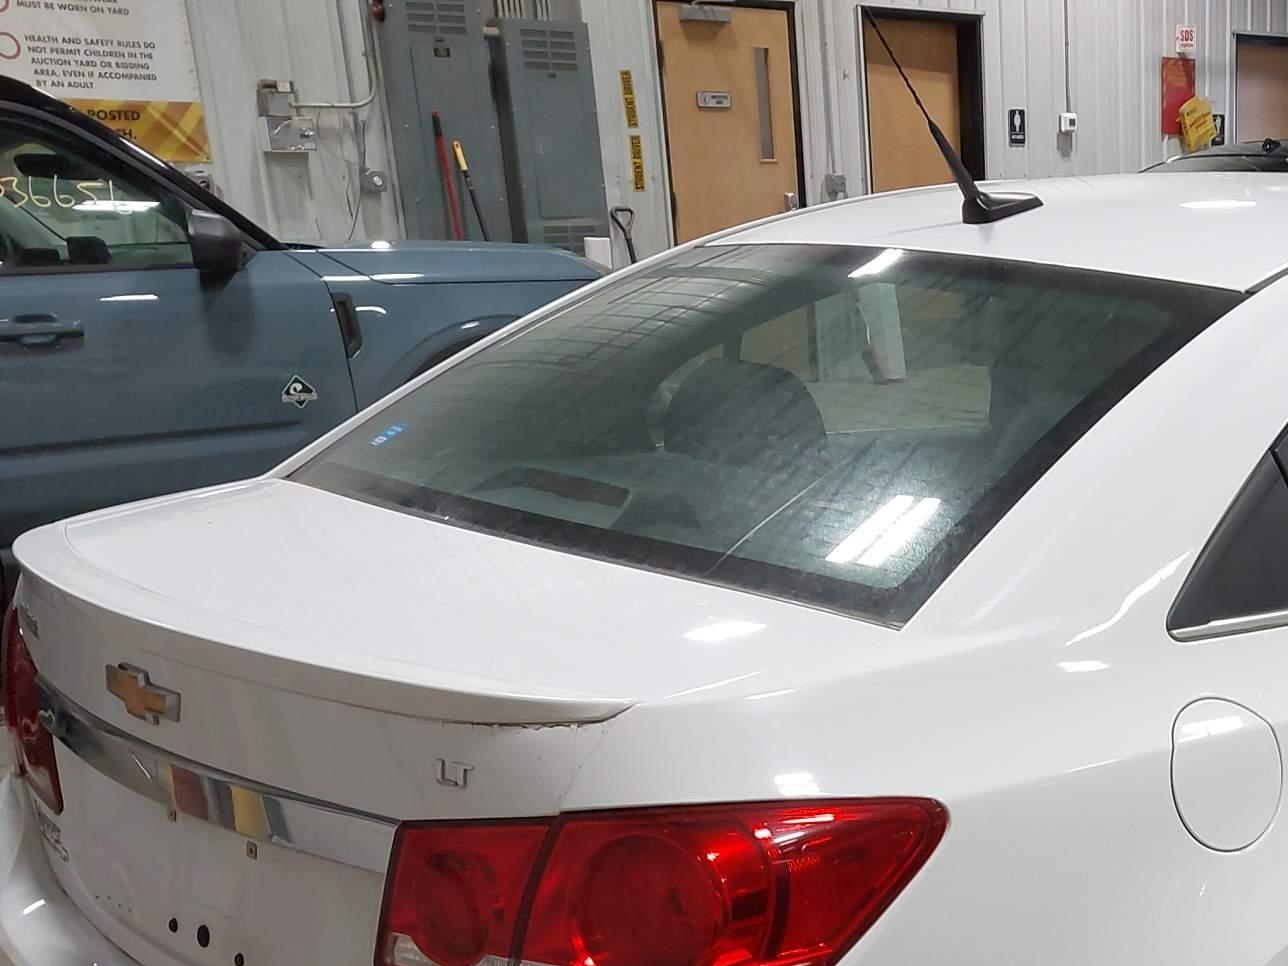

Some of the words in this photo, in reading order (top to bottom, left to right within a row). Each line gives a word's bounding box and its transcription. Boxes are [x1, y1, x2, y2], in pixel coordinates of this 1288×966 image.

[16, 0, 41, 9] MUST
[44, 2, 55, 10] BE
[57, 3, 87, 12] WORN
[90, 5, 104, 14] ON
[106, 6, 130, 16] YARD
[24, 34, 59, 44] HEALTH
[61, 36, 82, 45] AND
[83, 38, 114, 48] SAFETY
[116, 40, 141, 49] RULES
[143, 41, 156, 49] DO
[1180, 29, 1194, 42] SDS
[27, 45, 47, 54] NOT
[49, 47, 81, 56] PERMIT
[83, 49, 126, 59] CHILDREN
[139, 52, 153, 60] THE
[31, 57, 72, 66] AUCTION
[73, 59, 98, 68] YARD
[100, 60, 113, 69] OR
[115, 61, 150, 71] BIDDING
[33, 68, 60, 77] AREA,
[62, 70, 86, 78] EVEN
[97, 71, 158, 81] ACCOMPANIED
[36, 79, 47, 87] BY
[50, 80, 65, 88] AN
[67, 81, 95, 89] ADULT
[87, 109, 141, 121] POSTED
[435, 757, 475, 789] LT
